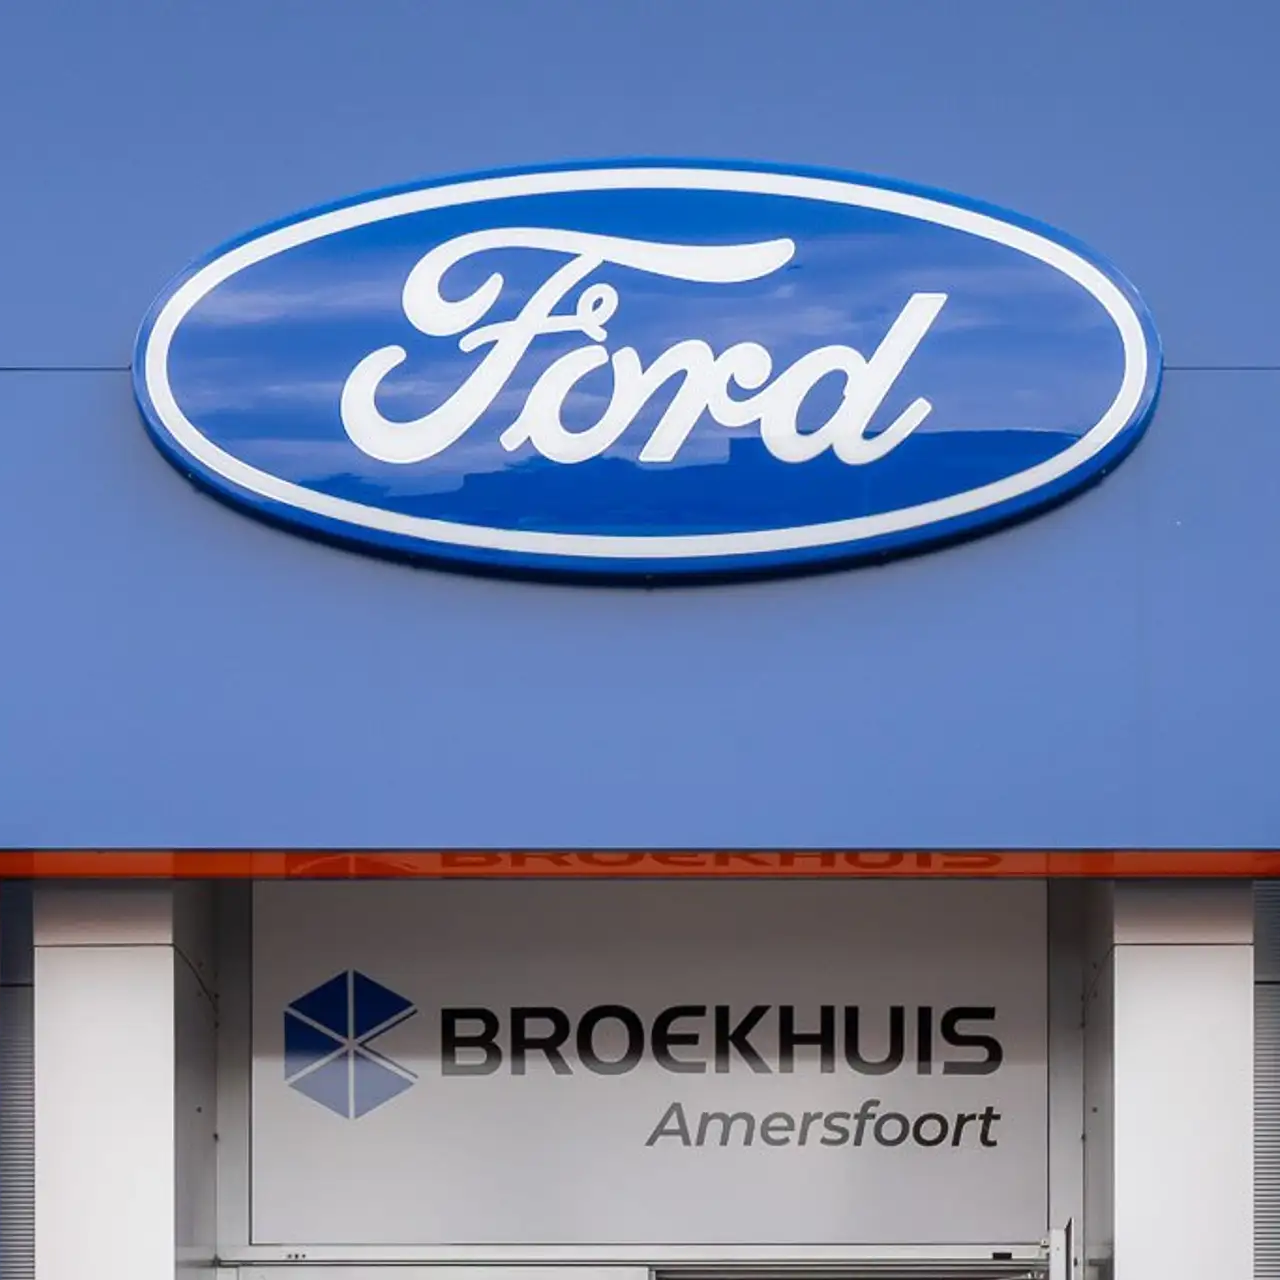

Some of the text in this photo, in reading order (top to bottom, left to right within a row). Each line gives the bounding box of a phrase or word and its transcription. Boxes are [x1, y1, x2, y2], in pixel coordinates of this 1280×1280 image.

[341, 228, 947, 464] Ford
[440, 1005, 1003, 1076] BROEKHUIS
[645, 1099, 1002, 1148] Amersfoort
